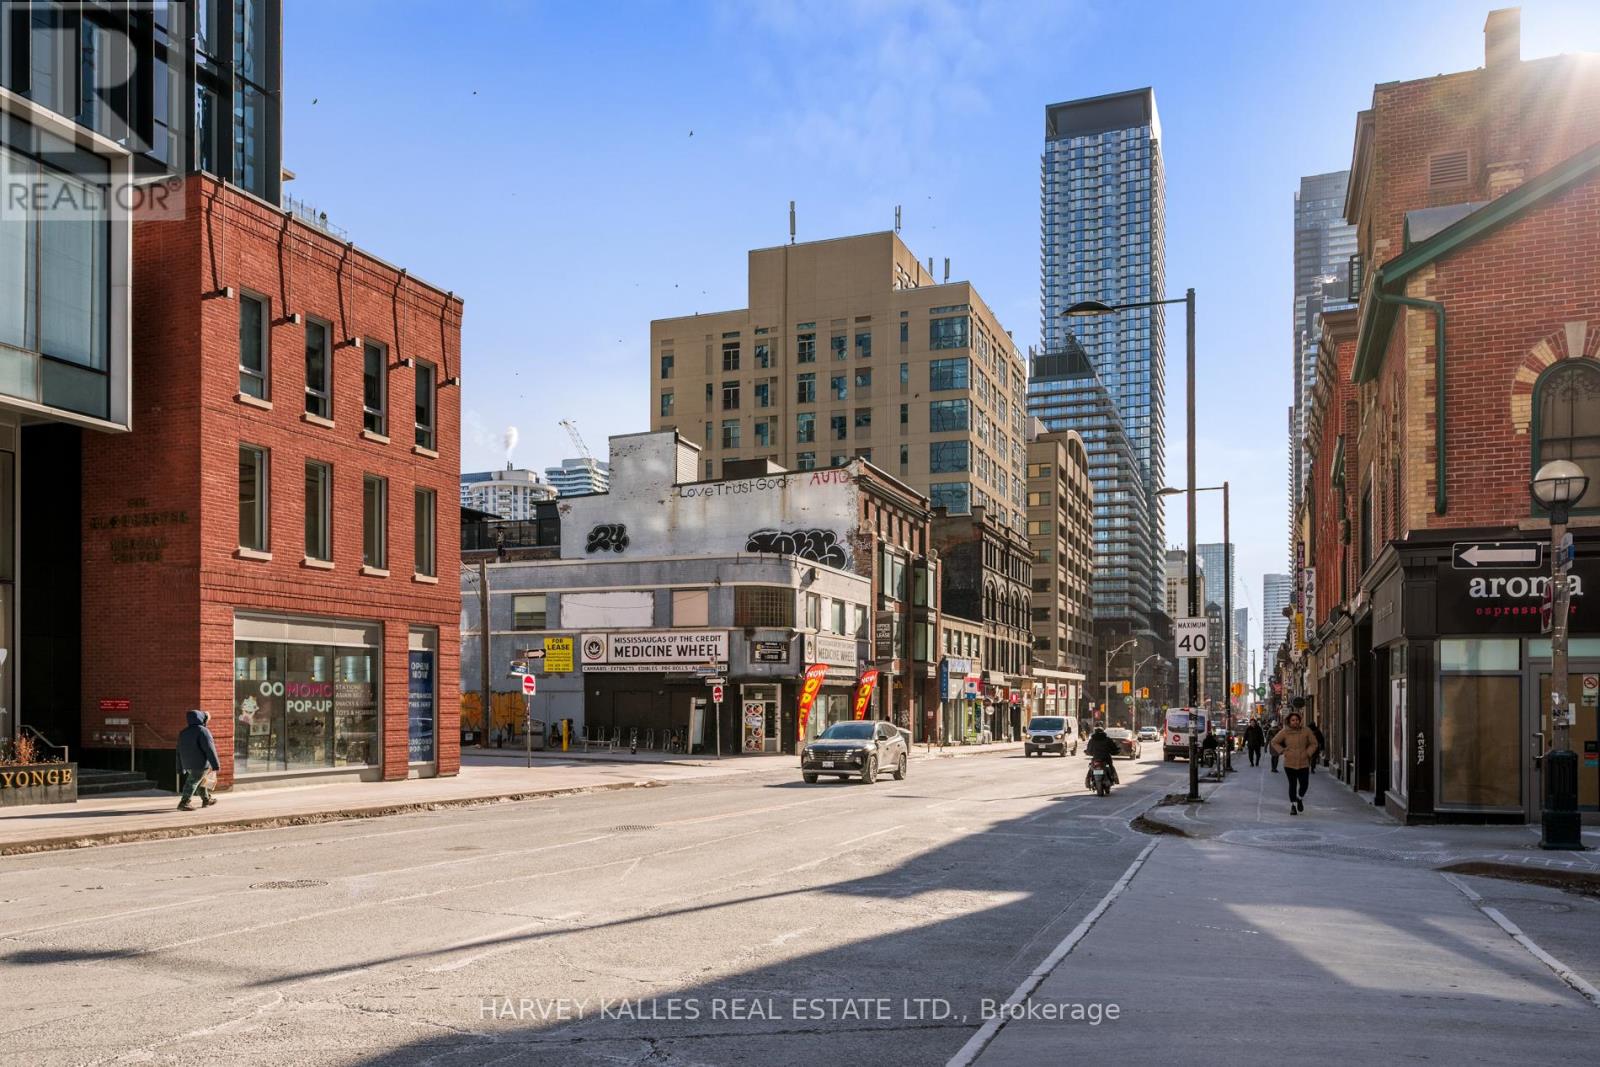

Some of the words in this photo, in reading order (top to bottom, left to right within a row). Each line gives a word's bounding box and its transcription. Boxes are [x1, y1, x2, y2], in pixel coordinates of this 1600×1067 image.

[1475, 605, 1545, 617] espress
[614, 636, 667, 644] MISSISSAUGAS
[680, 635, 694, 643] THE
[1178, 634, 1206, 652] 40
[614, 645, 673, 658] MEDICINE
[676, 644, 721, 657] WHEEL
[808, 669, 827, 678] NOW
[286, 700, 333, 713] POP-UP
[2, 769, 73, 788] YONGE
